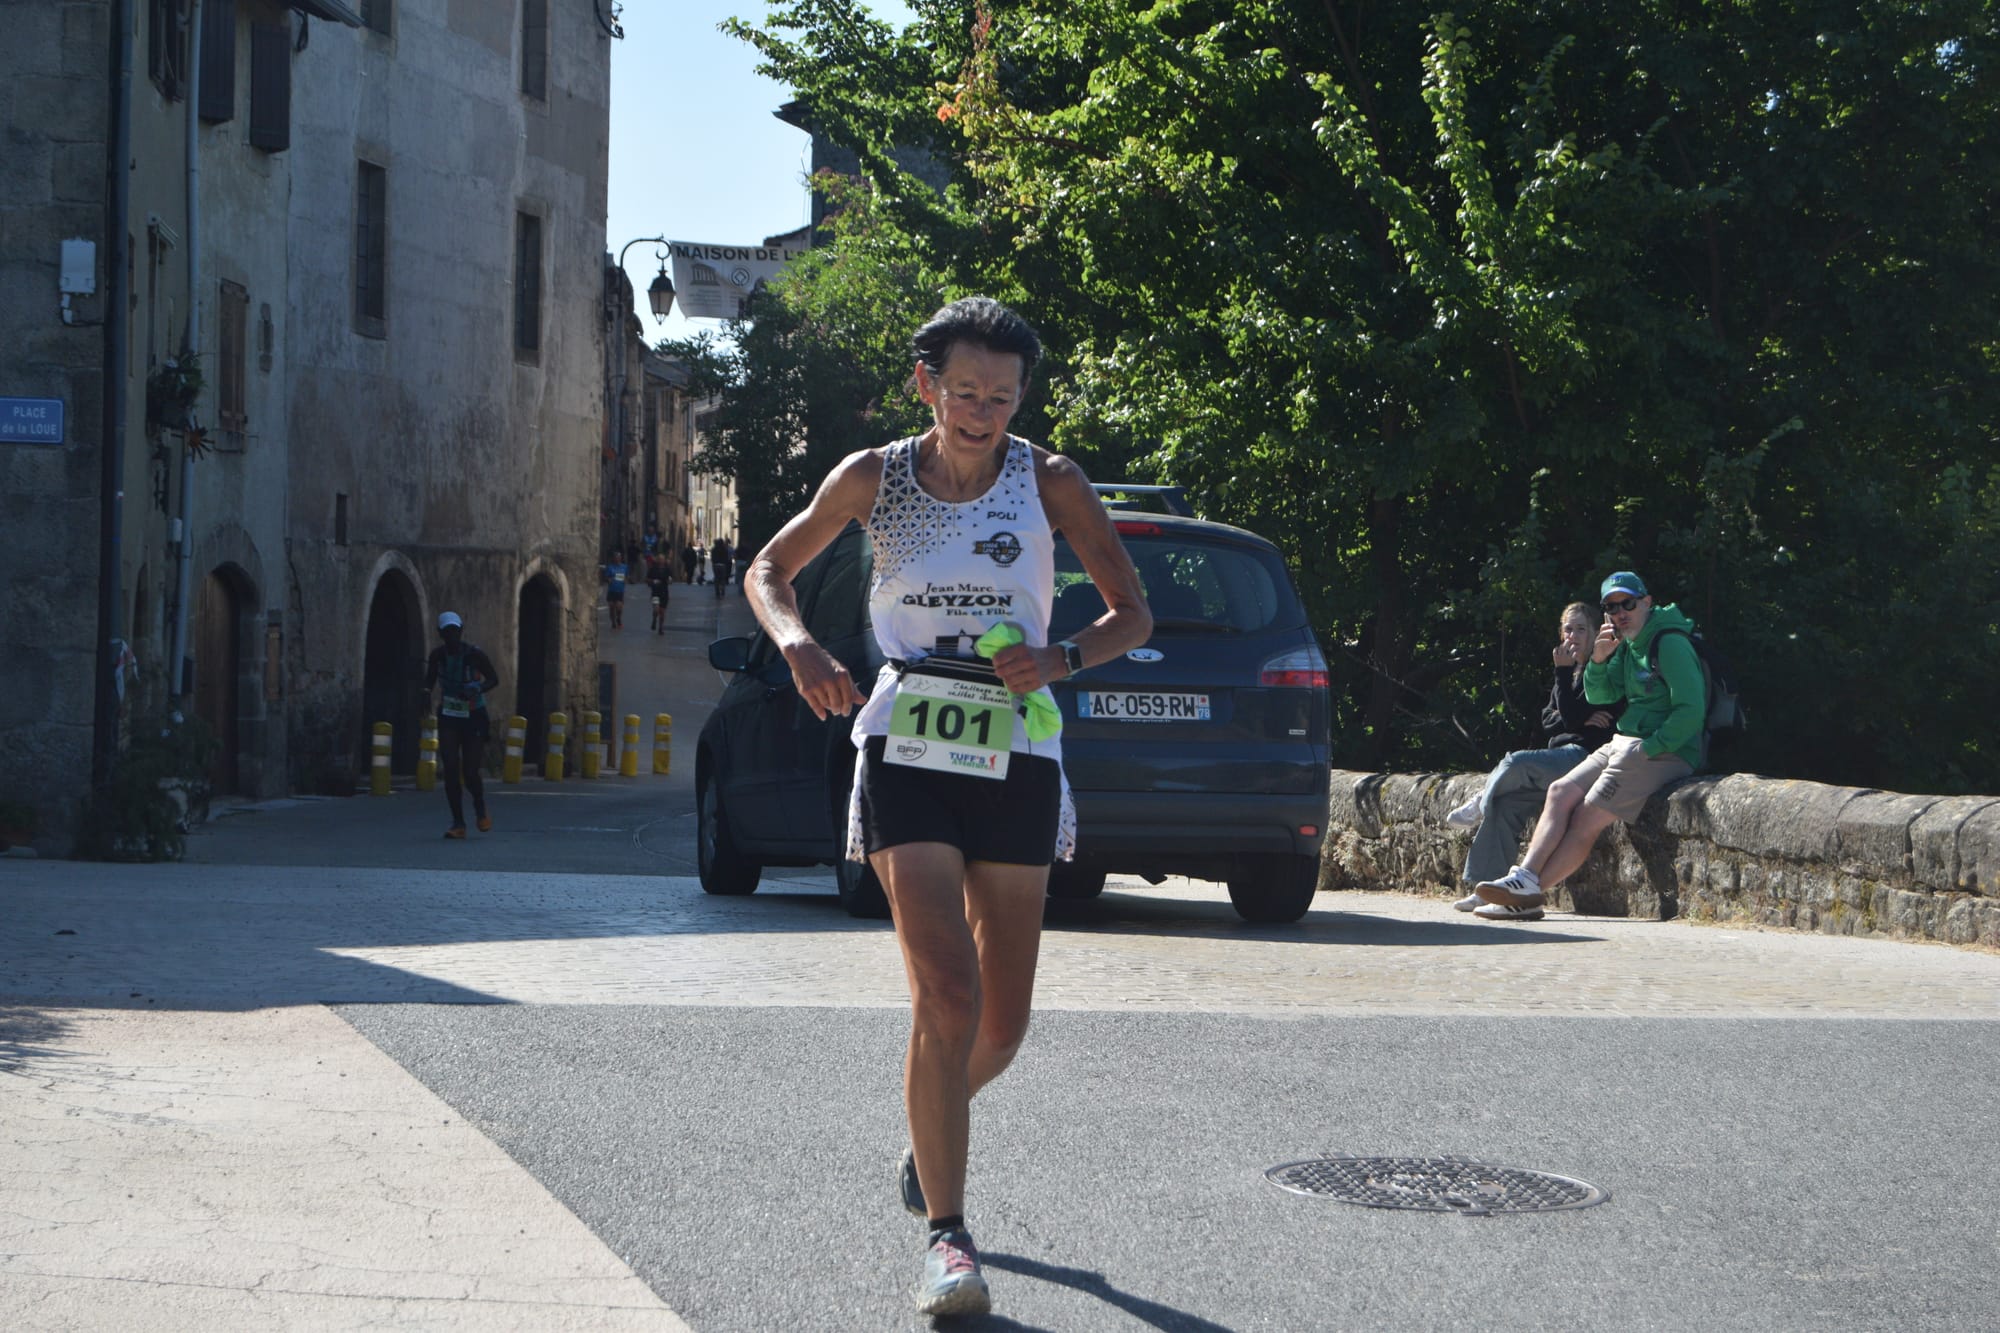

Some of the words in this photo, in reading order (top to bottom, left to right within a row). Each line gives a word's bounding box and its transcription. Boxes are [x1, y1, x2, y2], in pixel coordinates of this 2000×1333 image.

[676, 246, 749, 261] MAISON
[756, 249, 778, 261] DE
[13, 407, 47, 418] PLACE
[2, 424, 14, 433] de
[18, 424, 27, 434] la
[31, 424, 57, 435] LOUE
[987, 511, 1017, 521] POLI
[922, 582, 954, 595] Jean
[958, 583, 993, 593] Marc
[902, 594, 1013, 608] GLEYZON
[1199, 708, 1210, 718] 78
[909, 700, 992, 745] 101
[949, 752, 986, 764] TUFF'S
